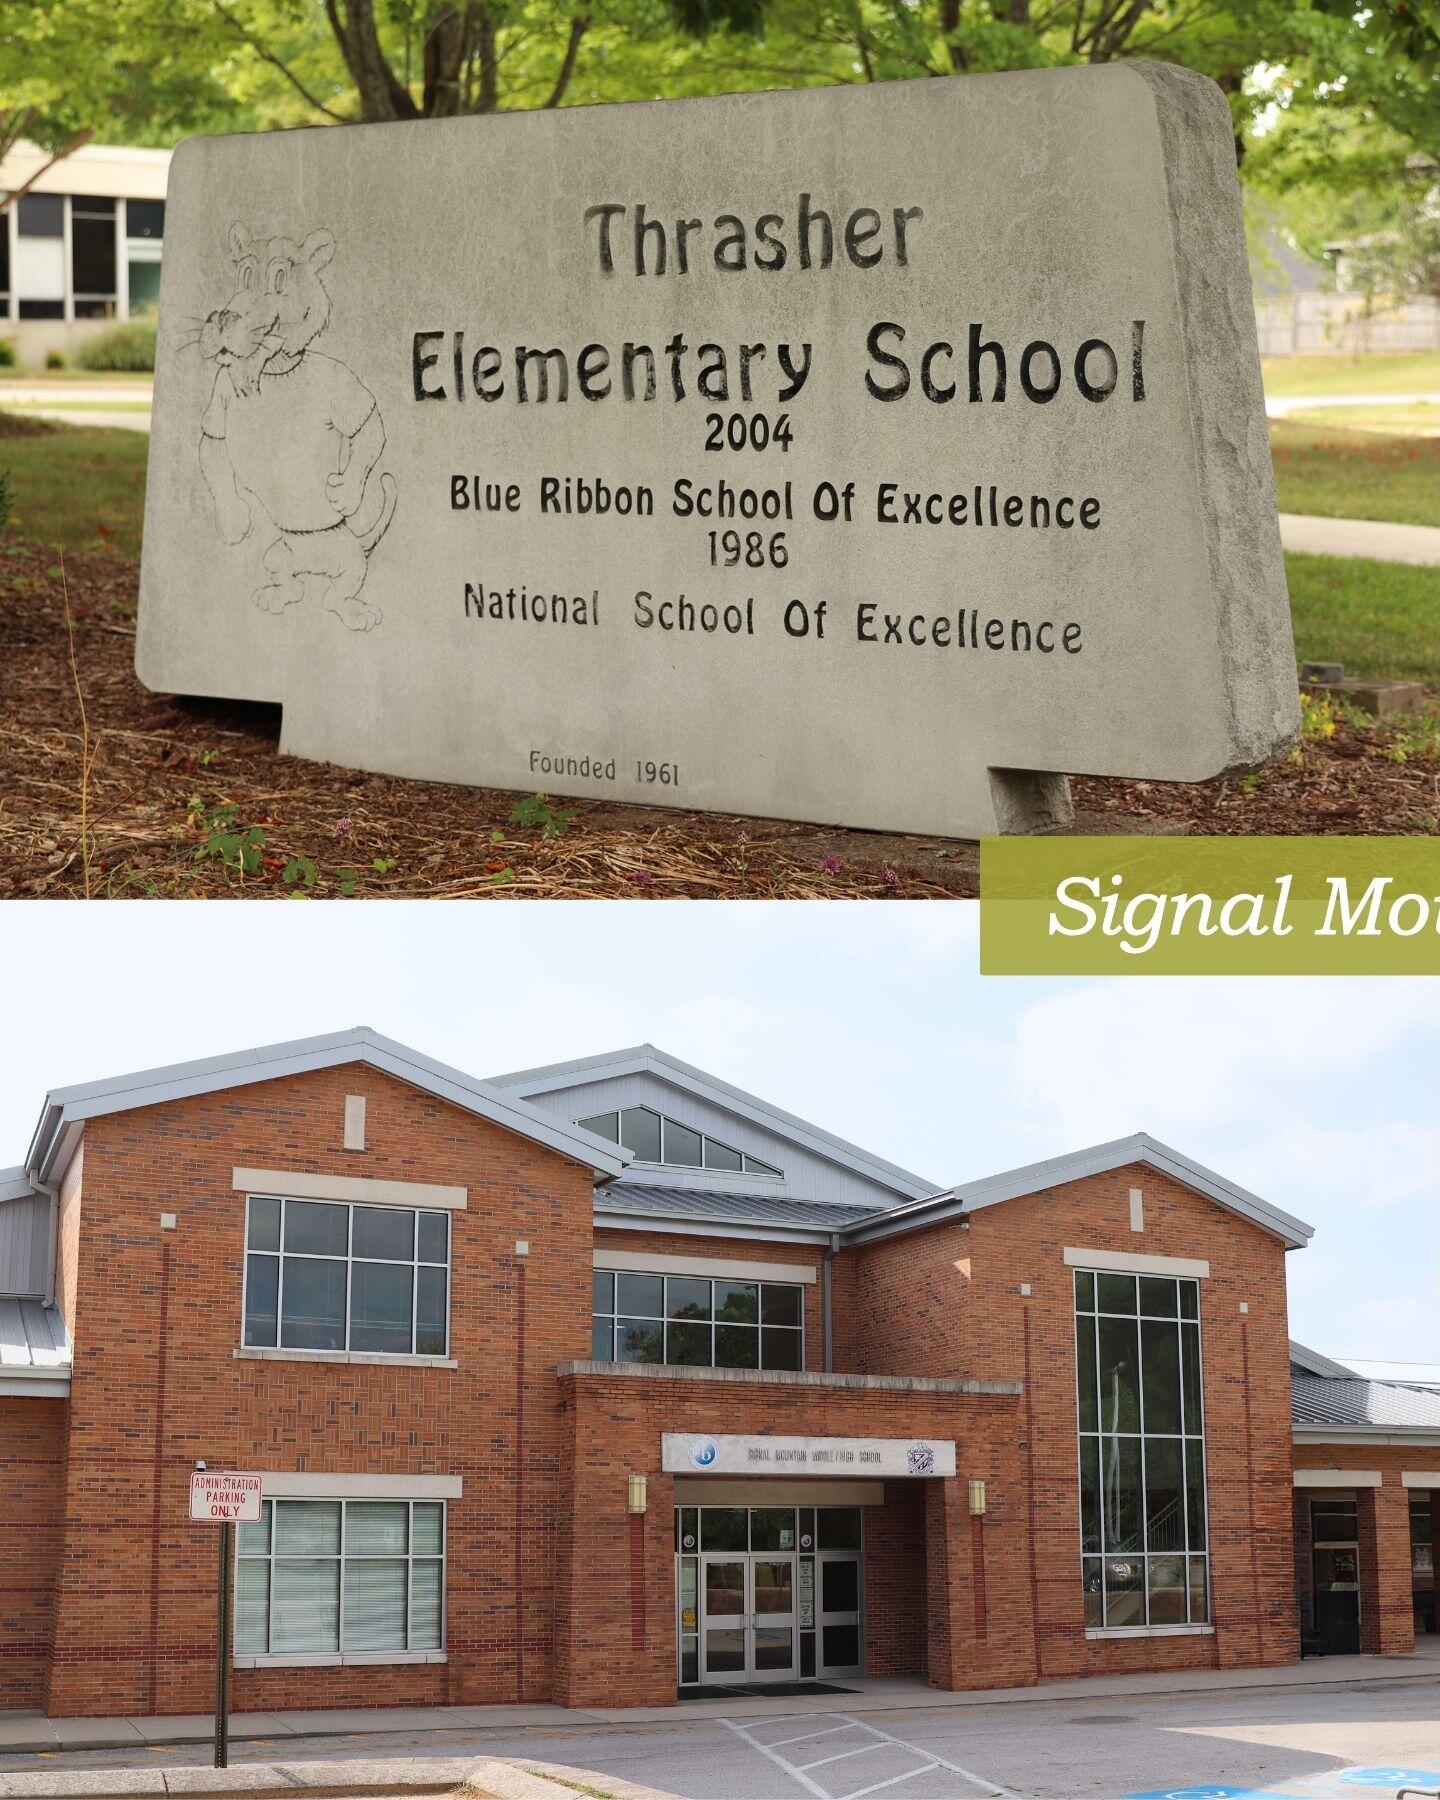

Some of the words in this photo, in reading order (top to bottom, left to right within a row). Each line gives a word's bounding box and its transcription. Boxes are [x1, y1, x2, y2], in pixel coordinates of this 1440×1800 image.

[584, 192, 924, 279] Thrasher
[412, 330, 813, 404] Elementary
[864, 319, 1148, 404] School
[704, 413, 795, 453] 2004
[450, 475, 521, 512] Blue
[540, 477, 654, 516] Ribbon
[672, 479, 793, 521] School
[813, 481, 855, 523] Of
[877, 483, 1102, 530] Excellence
[708, 531, 789, 569] 1986
[463, 582, 600, 626] National
[633, 591, 755, 636] School
[784, 600, 828, 639] Of
[857, 603, 1084, 655] Excellence
[529, 750, 617, 782] Founded
[635, 760, 680, 786] 1961
[859, 1450, 882, 1463] SCHOOL
[194, 1477, 259, 1491] ADMINISTRATION
[206, 1491, 246, 1504] PARKING
[210, 1505, 240, 1517] ONLY
